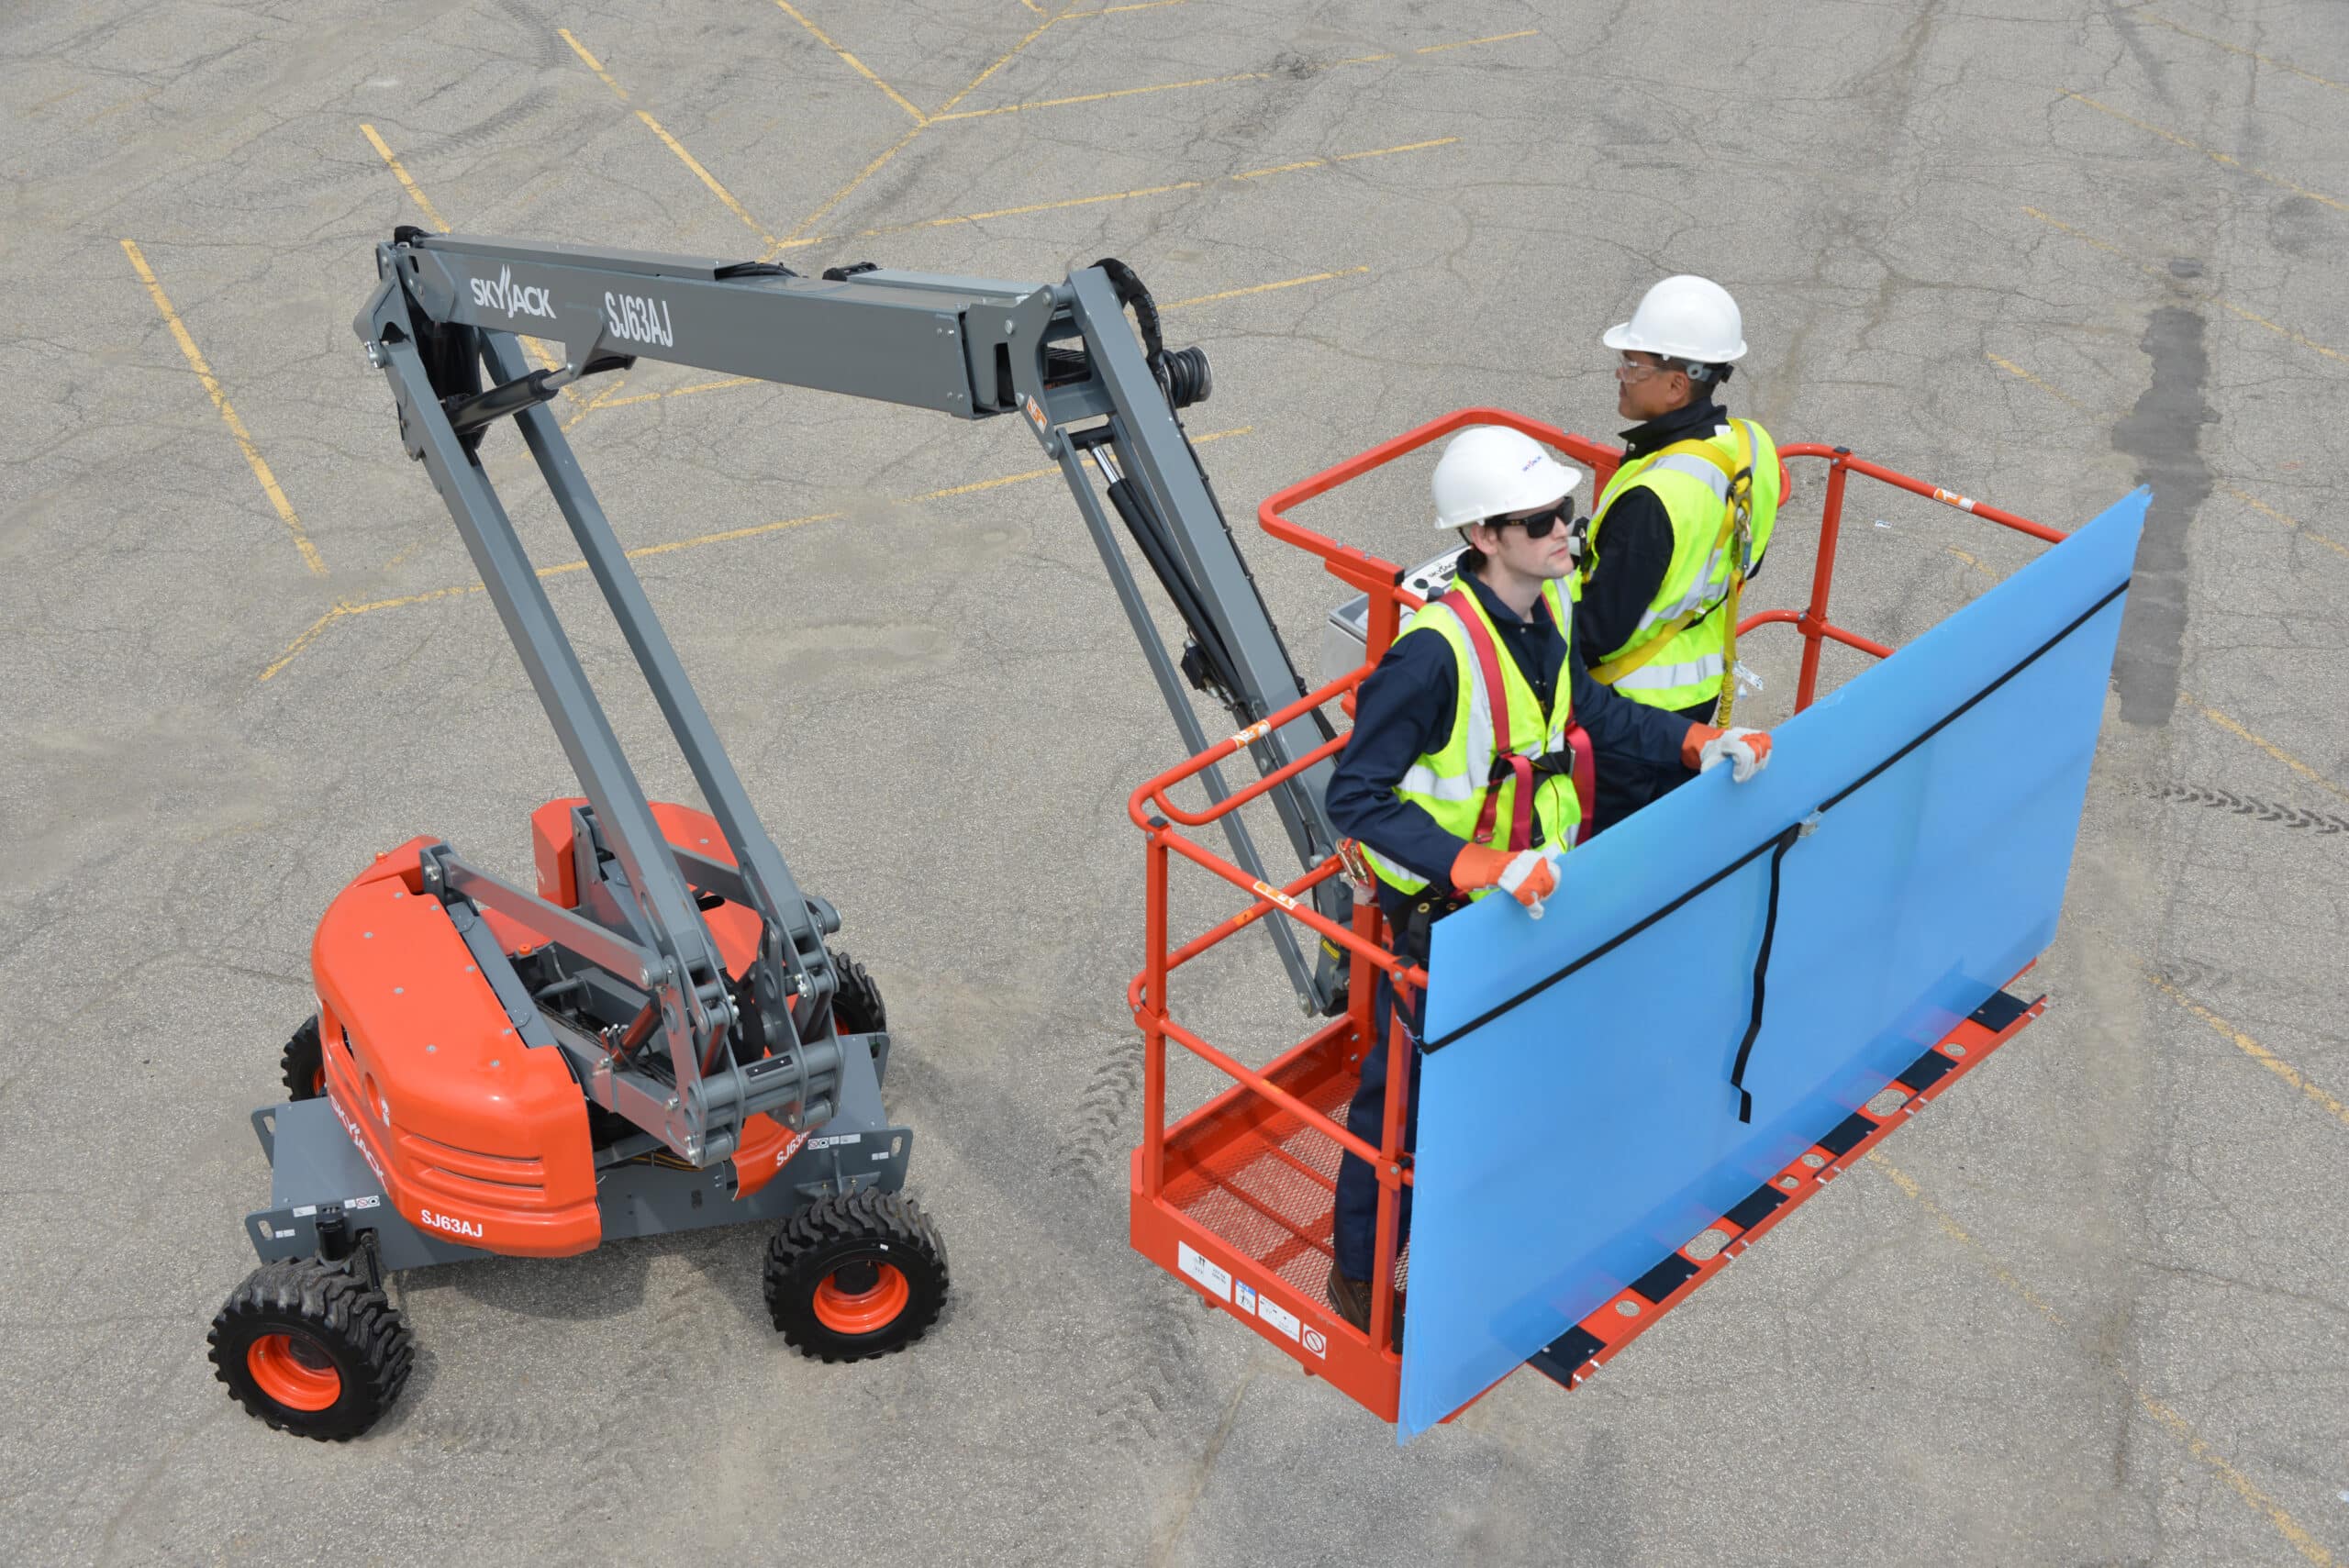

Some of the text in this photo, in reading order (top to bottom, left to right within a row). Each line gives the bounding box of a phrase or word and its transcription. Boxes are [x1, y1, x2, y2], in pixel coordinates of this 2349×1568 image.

[470, 263, 557, 319] SKYJACK
[604, 291, 674, 348] SJ63AJ
[420, 1208, 484, 1238] SJ63AJ
